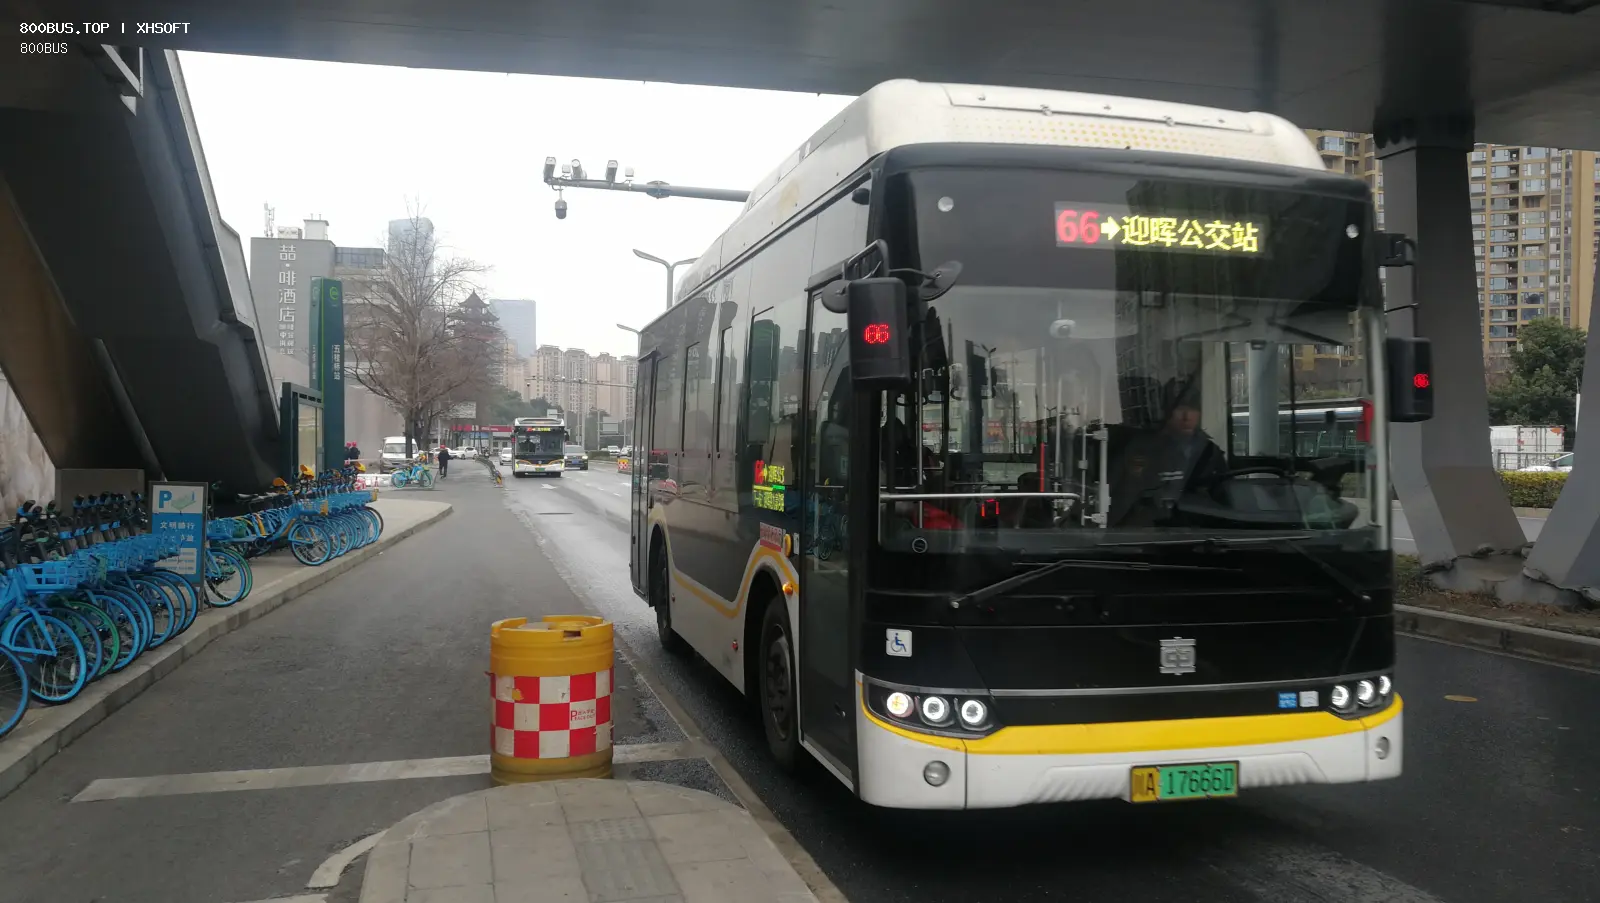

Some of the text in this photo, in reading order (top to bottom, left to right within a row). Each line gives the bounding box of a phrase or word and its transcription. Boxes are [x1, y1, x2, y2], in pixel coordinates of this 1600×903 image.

[1056, 209, 1260, 253] 66 迎晖公交站
[864, 323, 889, 345] 66
[158, 490, 173, 509] P
